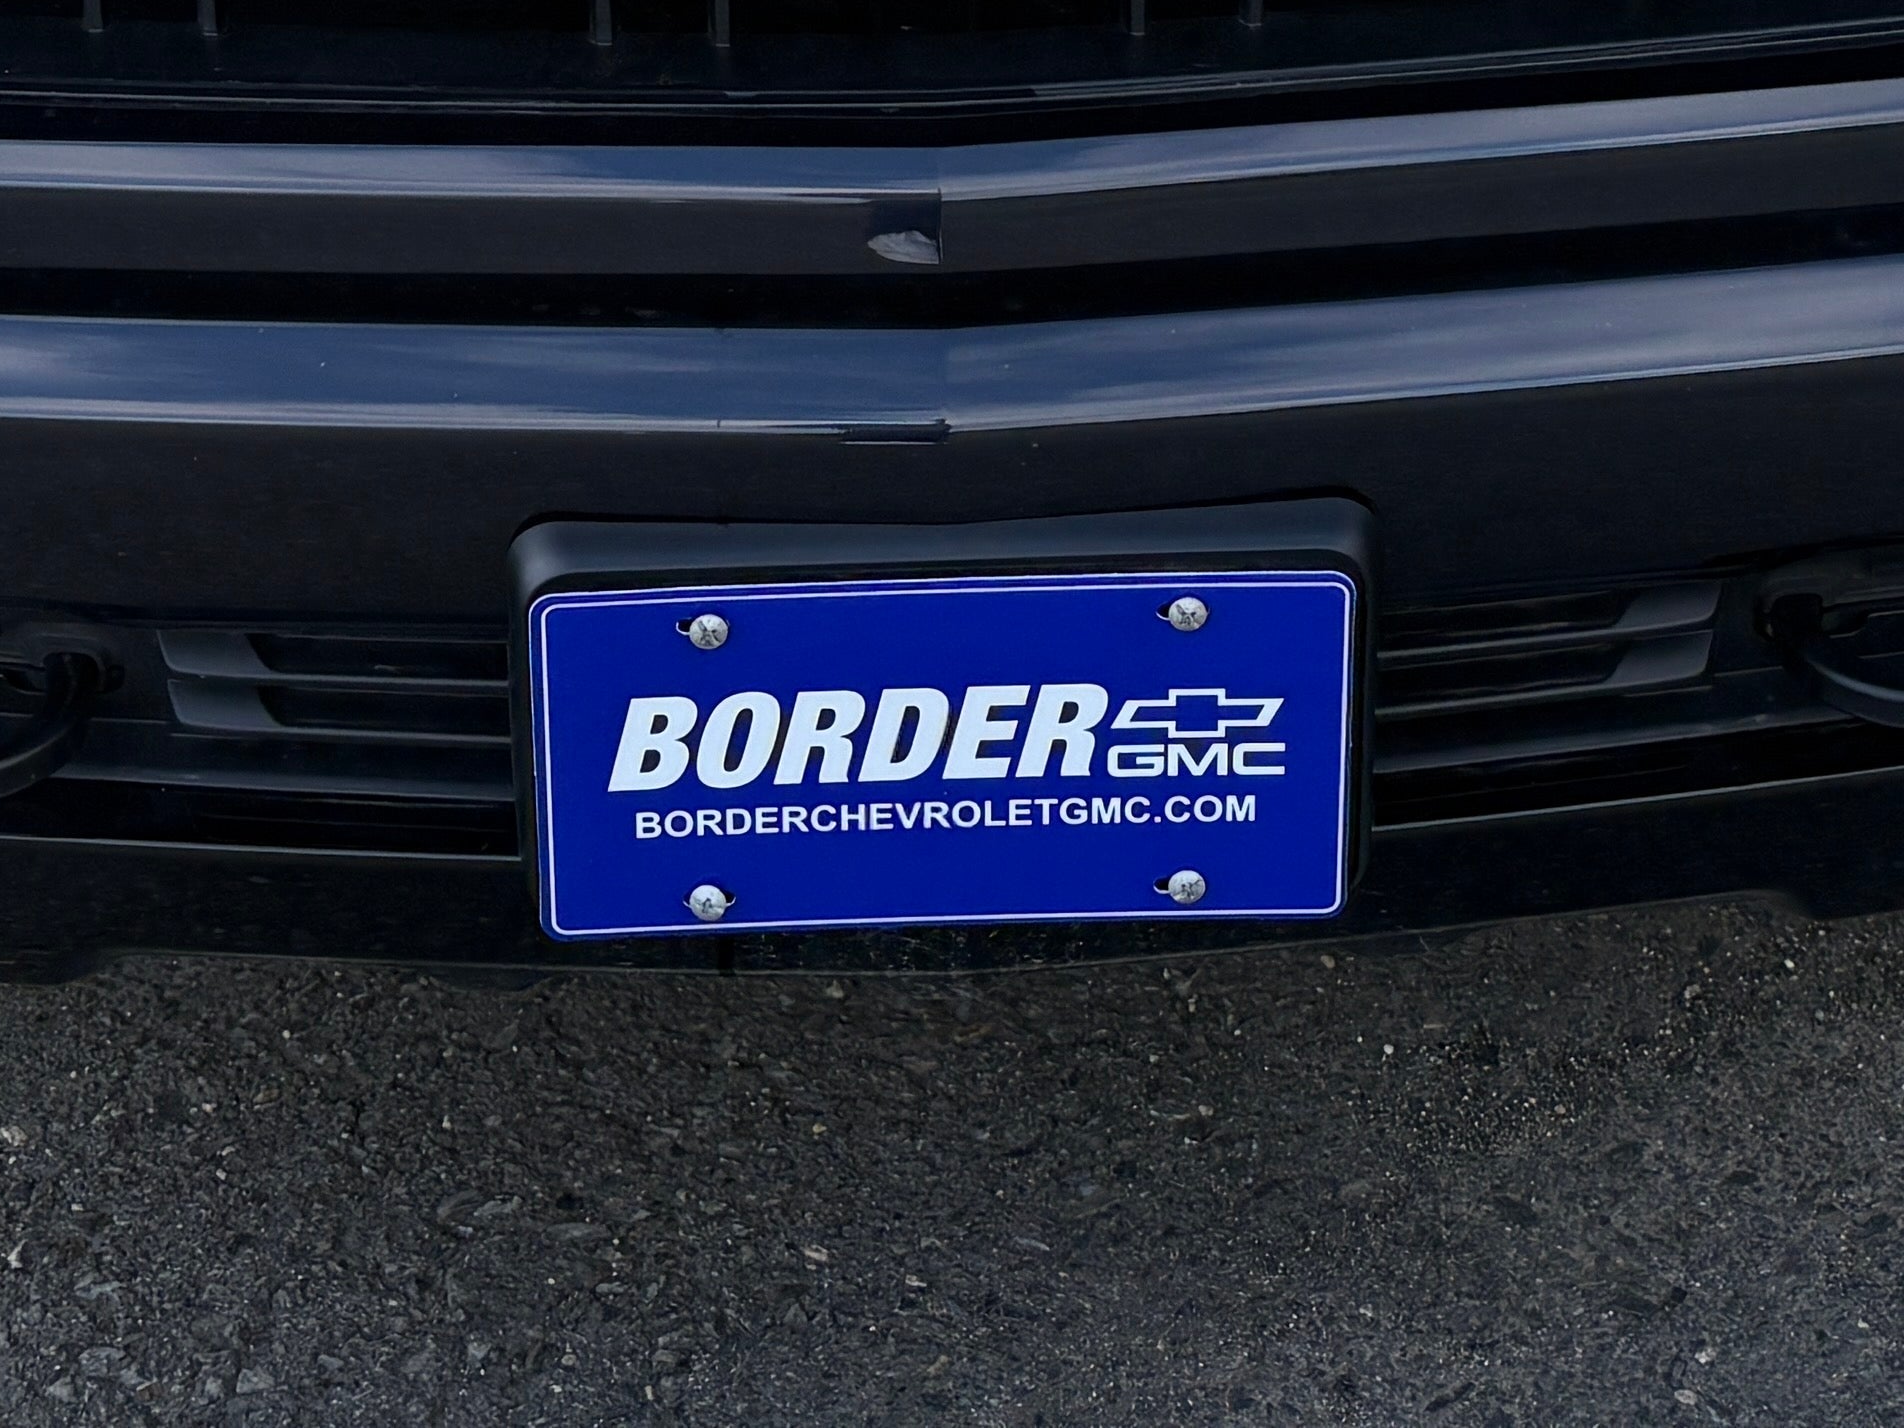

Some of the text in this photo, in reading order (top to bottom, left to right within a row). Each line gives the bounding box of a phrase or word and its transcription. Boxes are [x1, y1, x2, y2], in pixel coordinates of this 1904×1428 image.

[607, 683, 1109, 793] BORDER
[1107, 742, 1286, 778] GMC
[635, 794, 1256, 839] BORDERCHEVROLETGMC.COM
